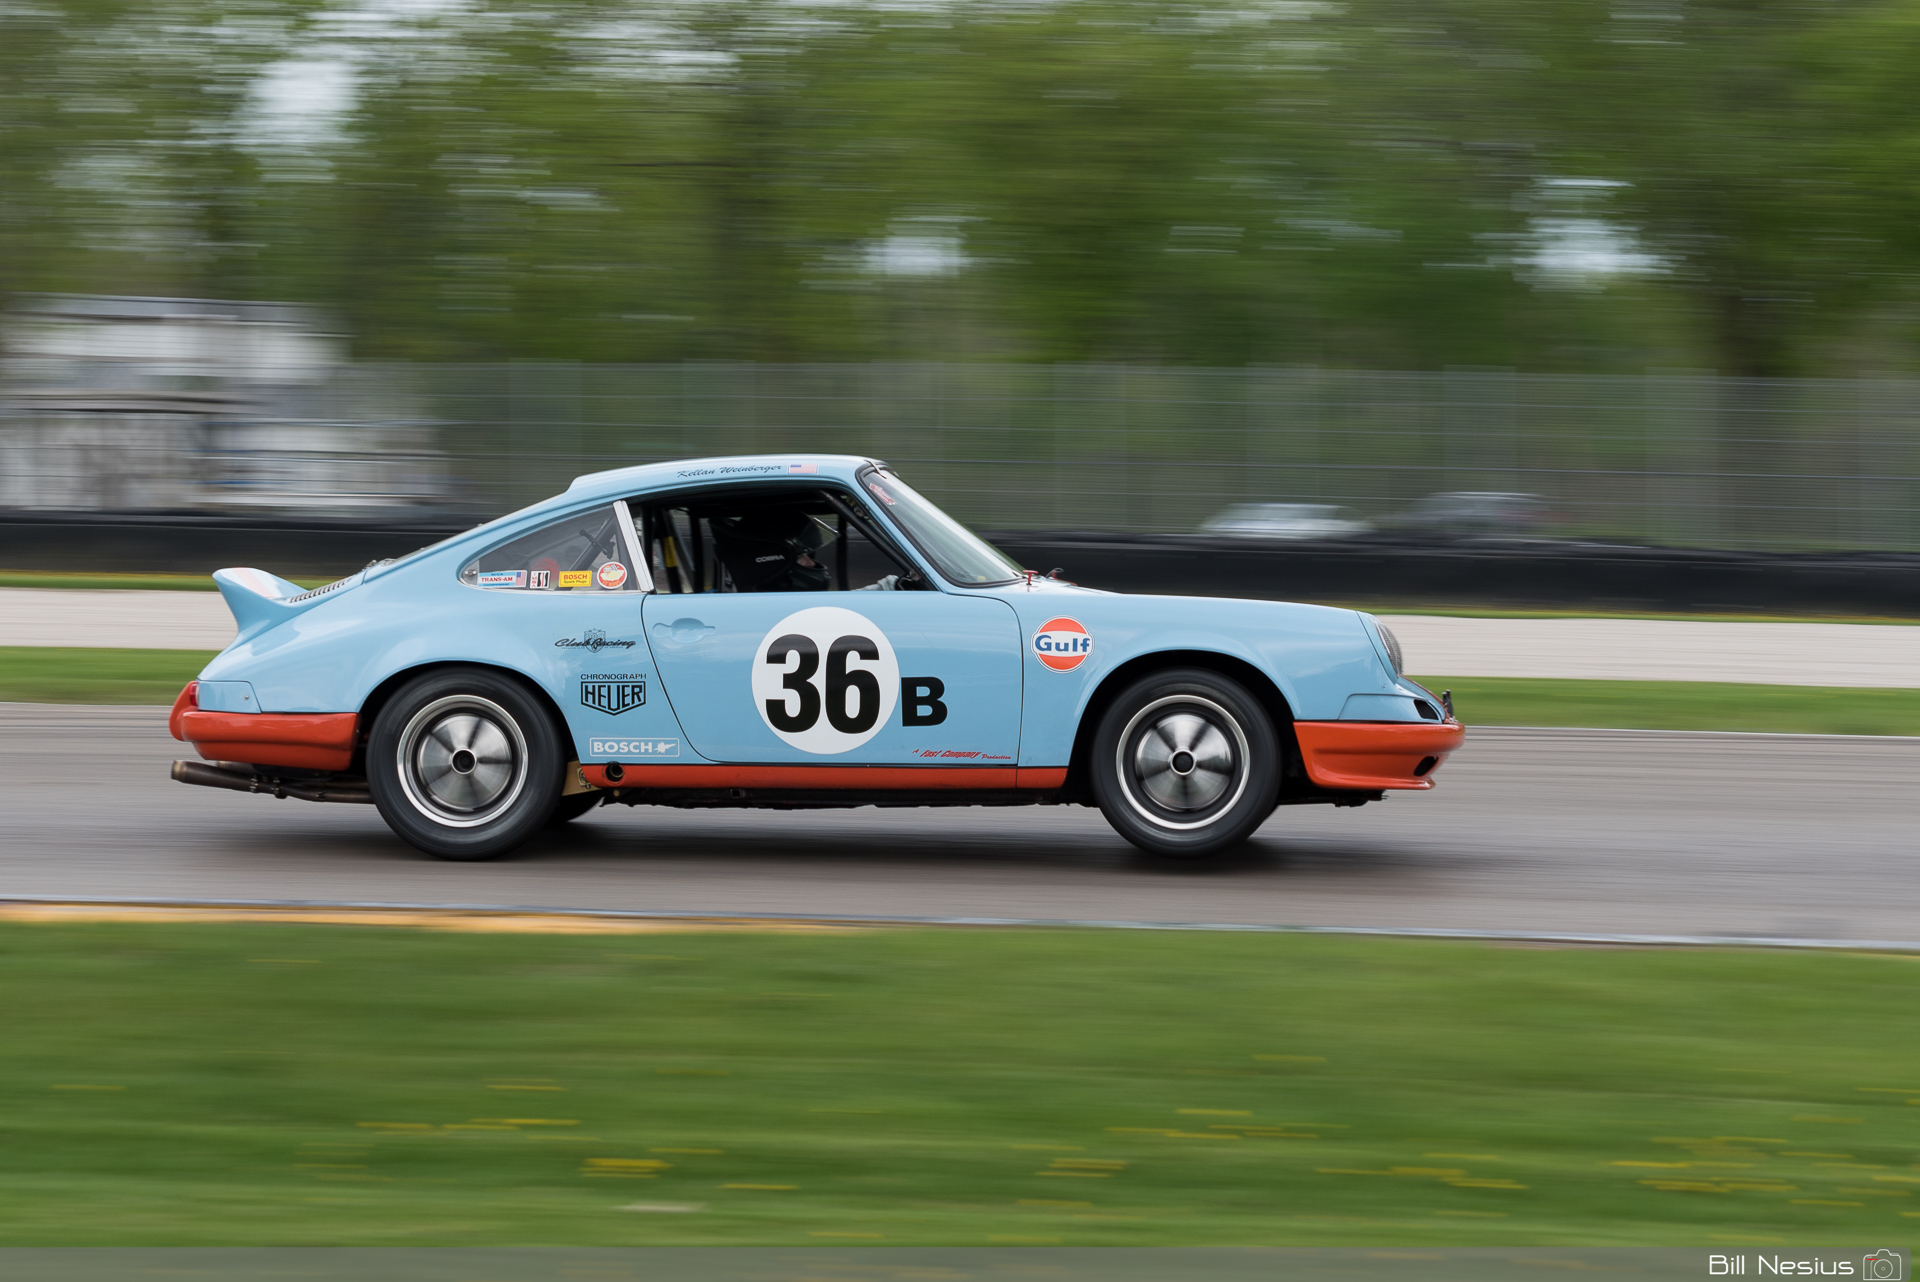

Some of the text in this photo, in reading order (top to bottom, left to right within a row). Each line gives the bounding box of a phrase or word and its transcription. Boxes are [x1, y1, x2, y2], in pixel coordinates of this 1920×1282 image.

[677, 464, 782, 478] Kellan Weinberger
[1035, 634, 1091, 653] Gulf
[580, 673, 647, 681] CHRONOGRAPH
[765, 633, 948, 734] 36 B
[584, 684, 643, 712] HEUER
[593, 741, 653, 753] BOSCH
